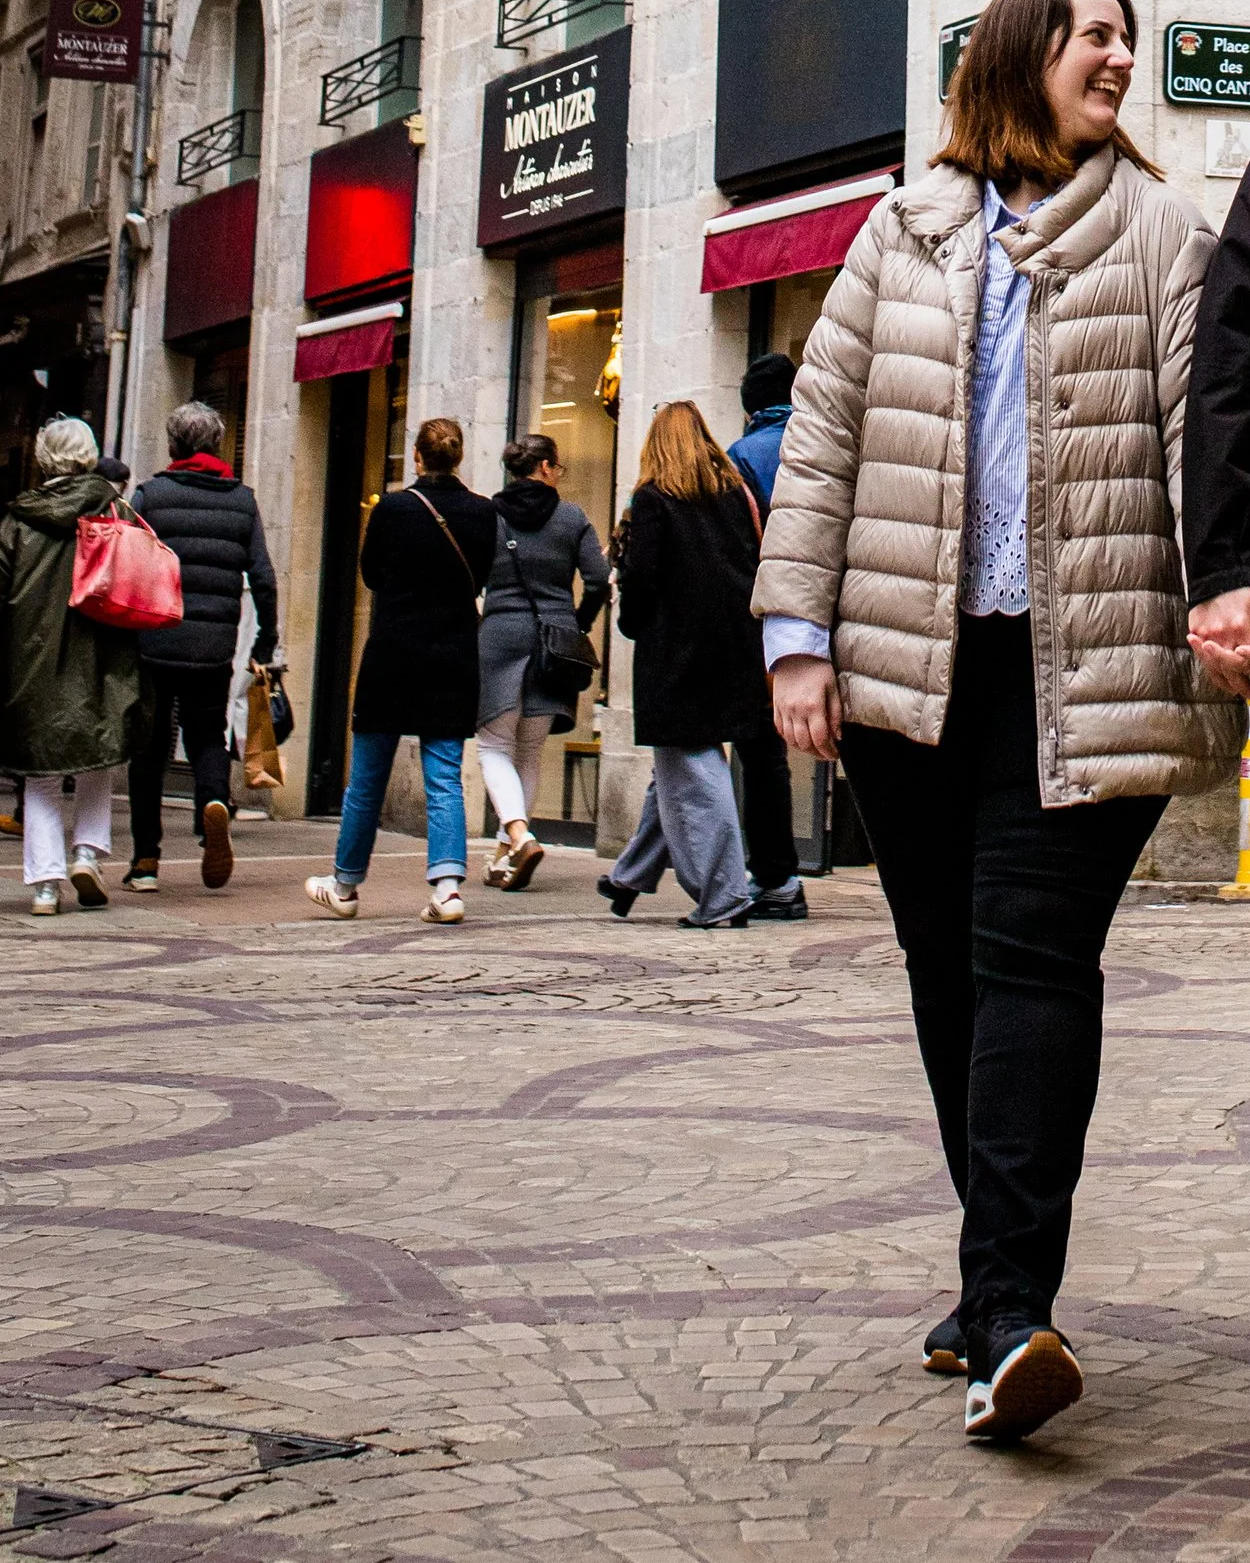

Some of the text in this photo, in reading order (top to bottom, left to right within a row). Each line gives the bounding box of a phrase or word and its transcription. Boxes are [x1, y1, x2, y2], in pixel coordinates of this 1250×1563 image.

[57, 37, 128, 55] MONTAUZER
[1213, 37, 1250, 54] Place
[1219, 59, 1244, 74] des
[506, 64, 598, 111] MAISON
[1173, 76, 1213, 95] CINQ
[503, 86, 596, 152] MONTAUZER
